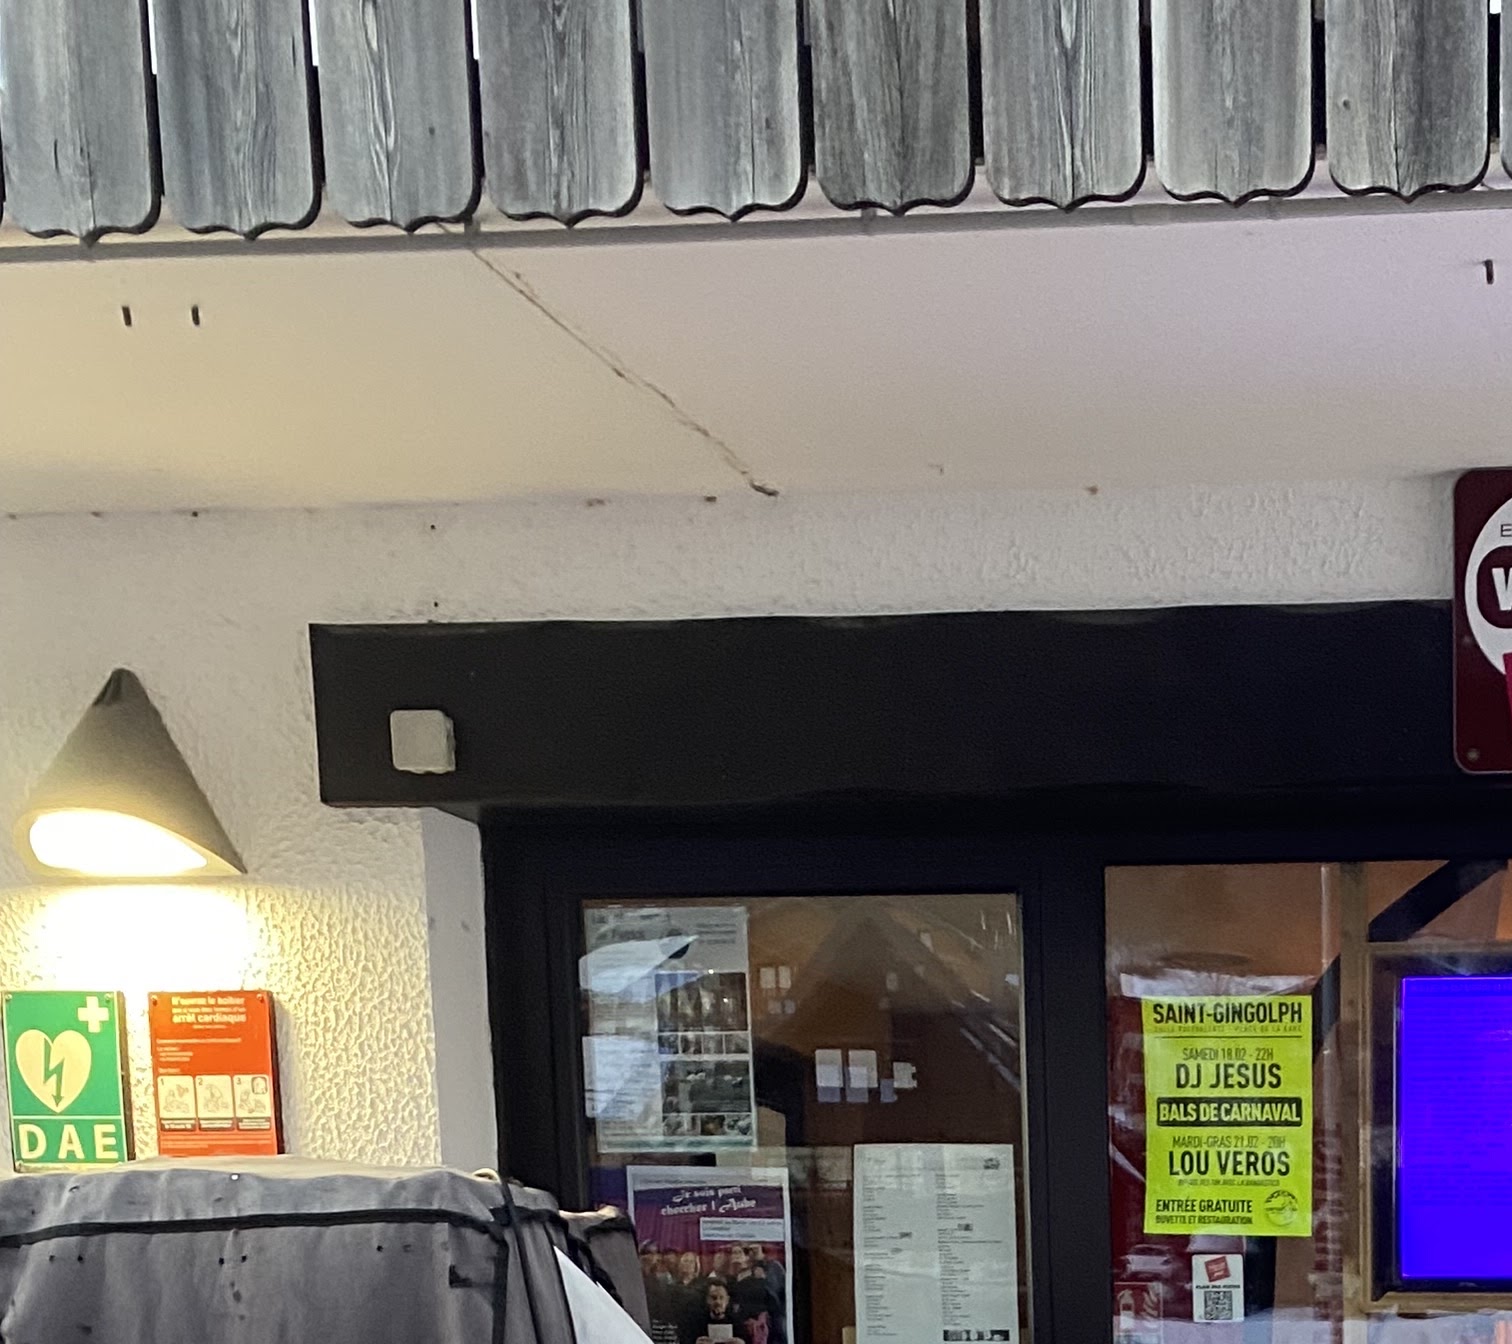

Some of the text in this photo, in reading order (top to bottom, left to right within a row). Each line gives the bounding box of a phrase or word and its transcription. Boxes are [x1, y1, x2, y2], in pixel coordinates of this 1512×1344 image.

[1152, 1001, 1303, 1024] SAINT-GINGOLPH
[1182, 1047, 1218, 1061] SAMEDI
[1255, 1047, 1274, 1061] 22H
[1175, 1063, 1282, 1089] DJ JESUS
[1159, 1102, 1301, 1121] BALS DE CARNAVAL
[18, 1123, 119, 1160] DAE
[1169, 1150, 1291, 1176] LOU VEROS
[1156, 1196, 1253, 1213] ENTRÉE GRATUITE
[1188, 1215, 1197, 1224] ET
